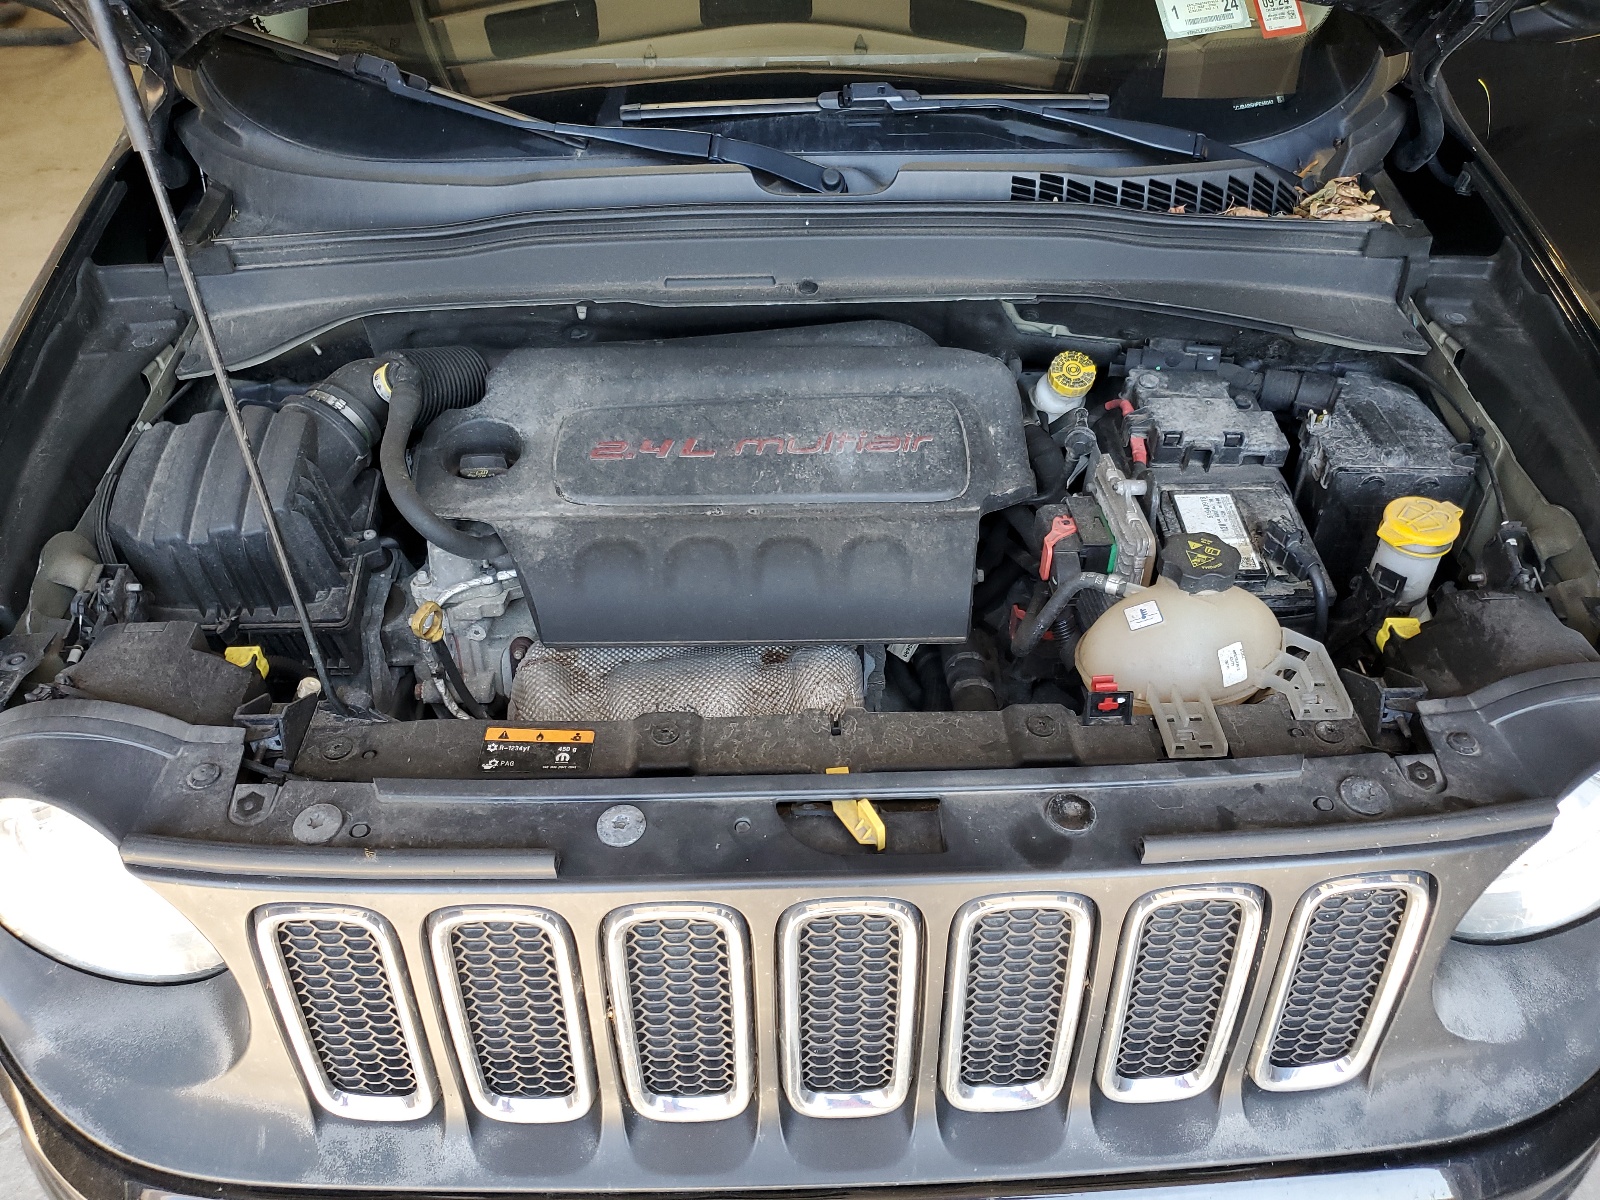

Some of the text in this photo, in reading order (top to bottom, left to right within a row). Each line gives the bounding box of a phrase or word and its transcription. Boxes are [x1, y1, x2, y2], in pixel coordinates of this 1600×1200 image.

[1171, 5, 1179, 19] 1
[1221, 0, 1239, 12] 24
[734, 431, 933, 456] multiair
